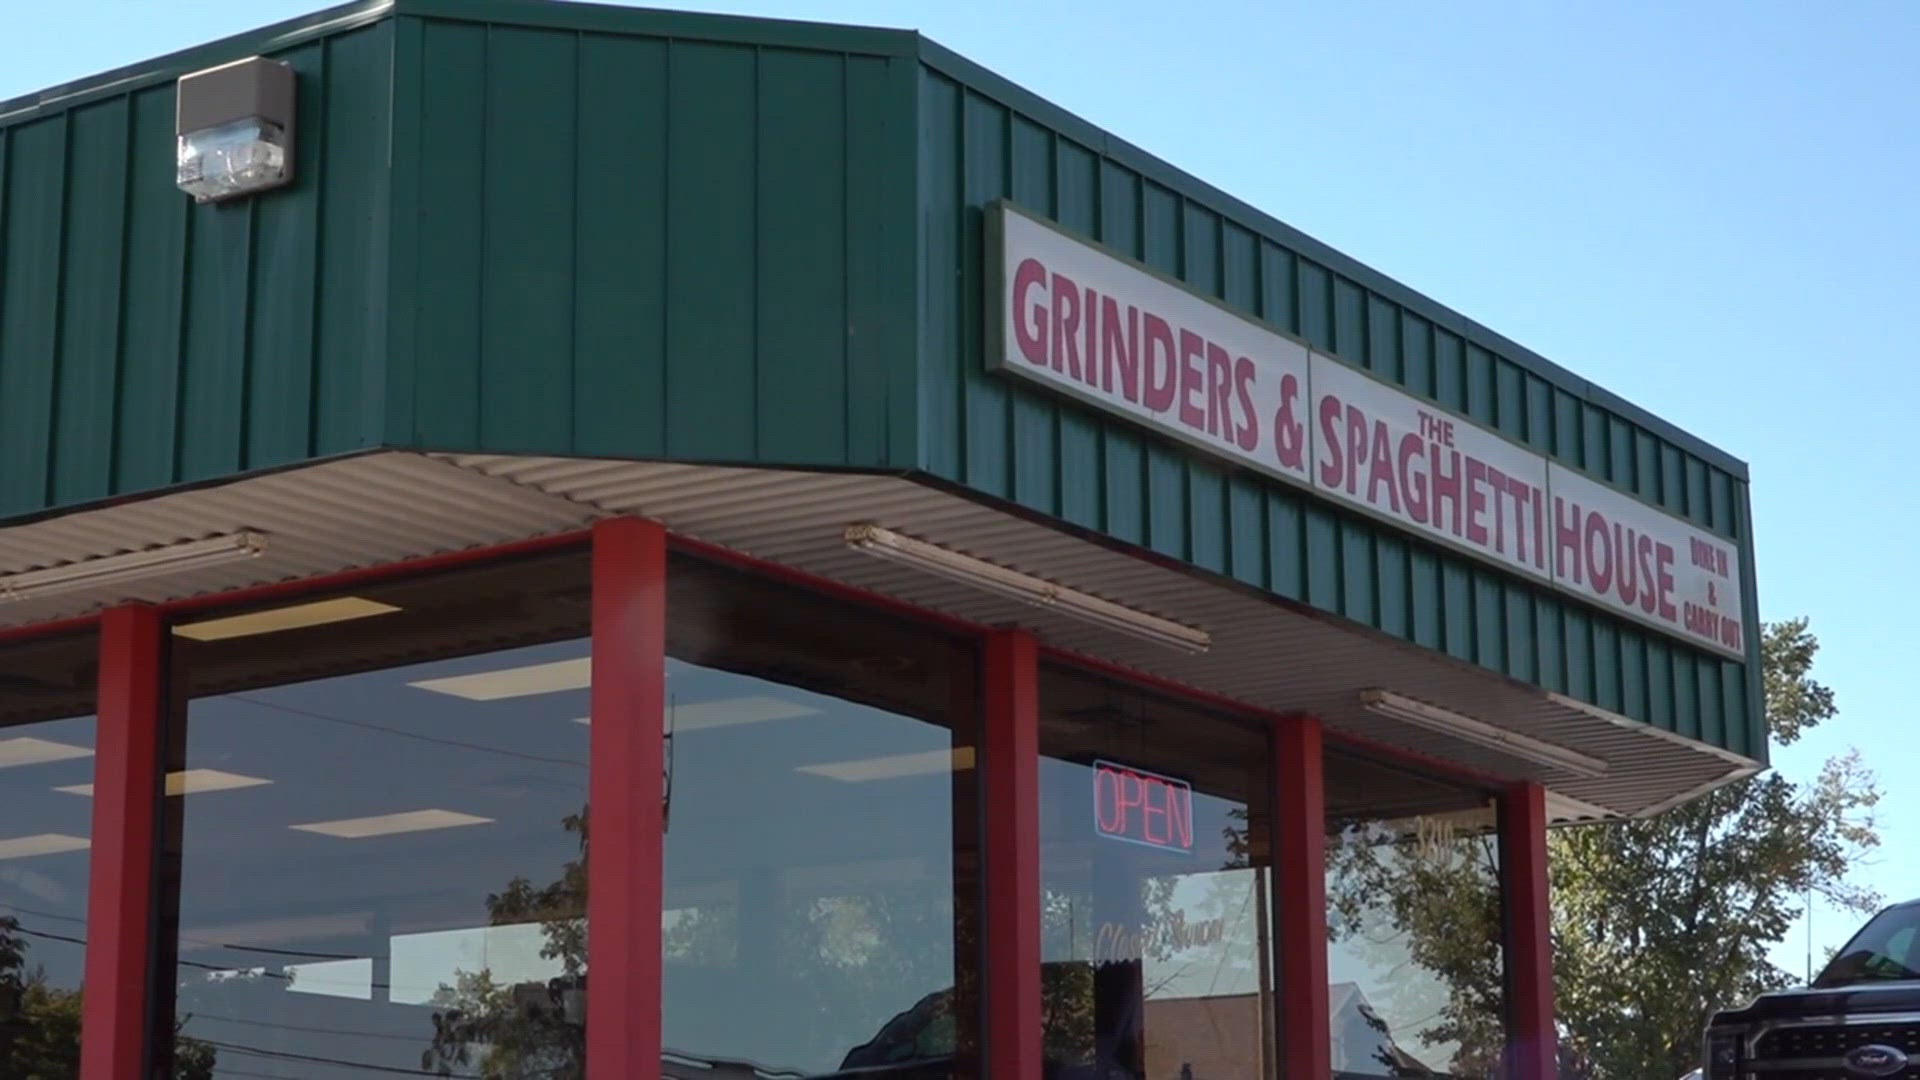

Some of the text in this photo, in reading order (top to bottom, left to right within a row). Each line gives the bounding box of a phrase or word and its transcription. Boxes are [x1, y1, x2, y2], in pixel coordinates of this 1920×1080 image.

[1012, 257, 1304, 472] GRINDERS &
[1417, 409, 1454, 449] THE
[1319, 394, 1677, 624] SPAGHETTI HOUSE
[1684, 601, 1740, 652] CARRY OUT
[1097, 767, 1191, 849] OPEN
